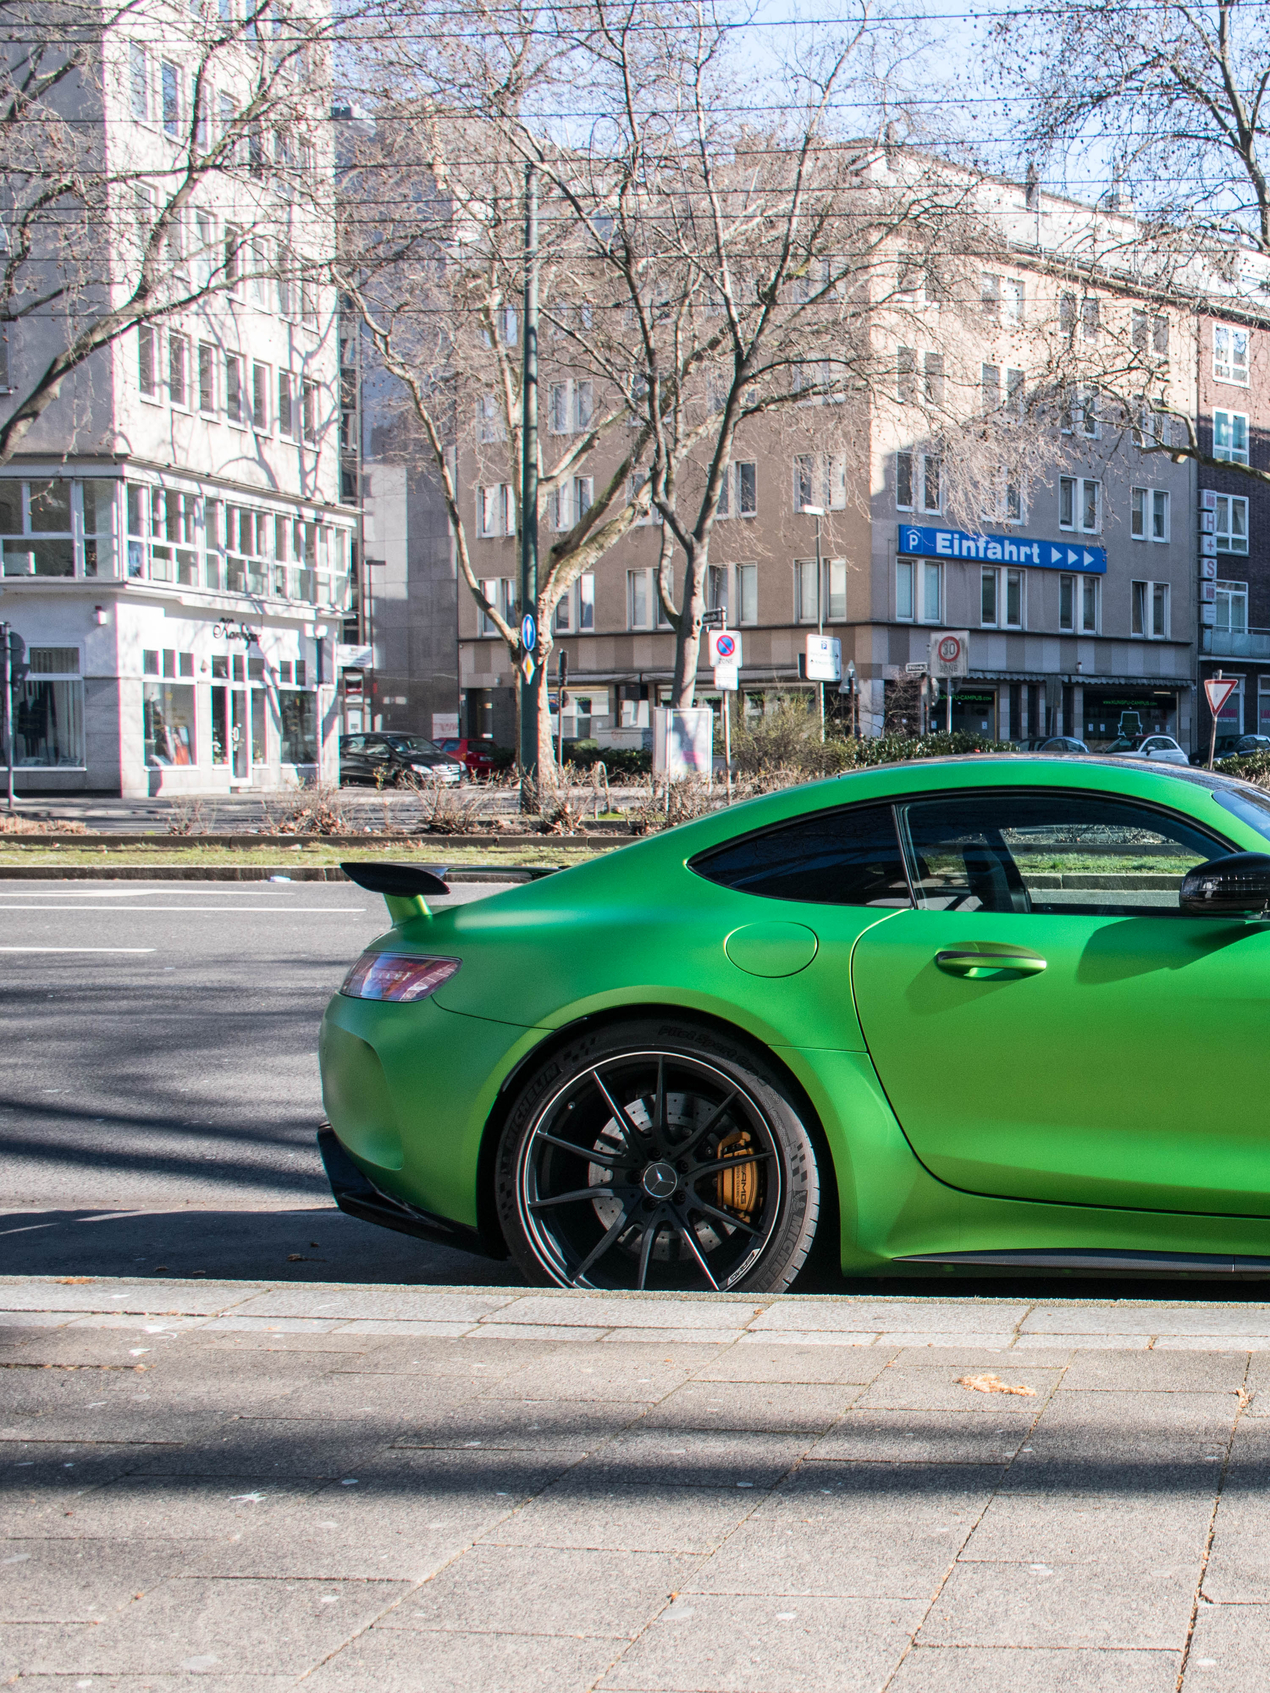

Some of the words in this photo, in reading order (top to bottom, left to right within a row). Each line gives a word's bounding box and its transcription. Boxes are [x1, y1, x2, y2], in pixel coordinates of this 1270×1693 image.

[1206, 514, 1215, 531] H
[936, 532, 1040, 564] Einfahrt
[1206, 560, 1215, 578] S
[942, 643, 956, 656] 30
[504, 1061, 562, 1150] MICHELIN
